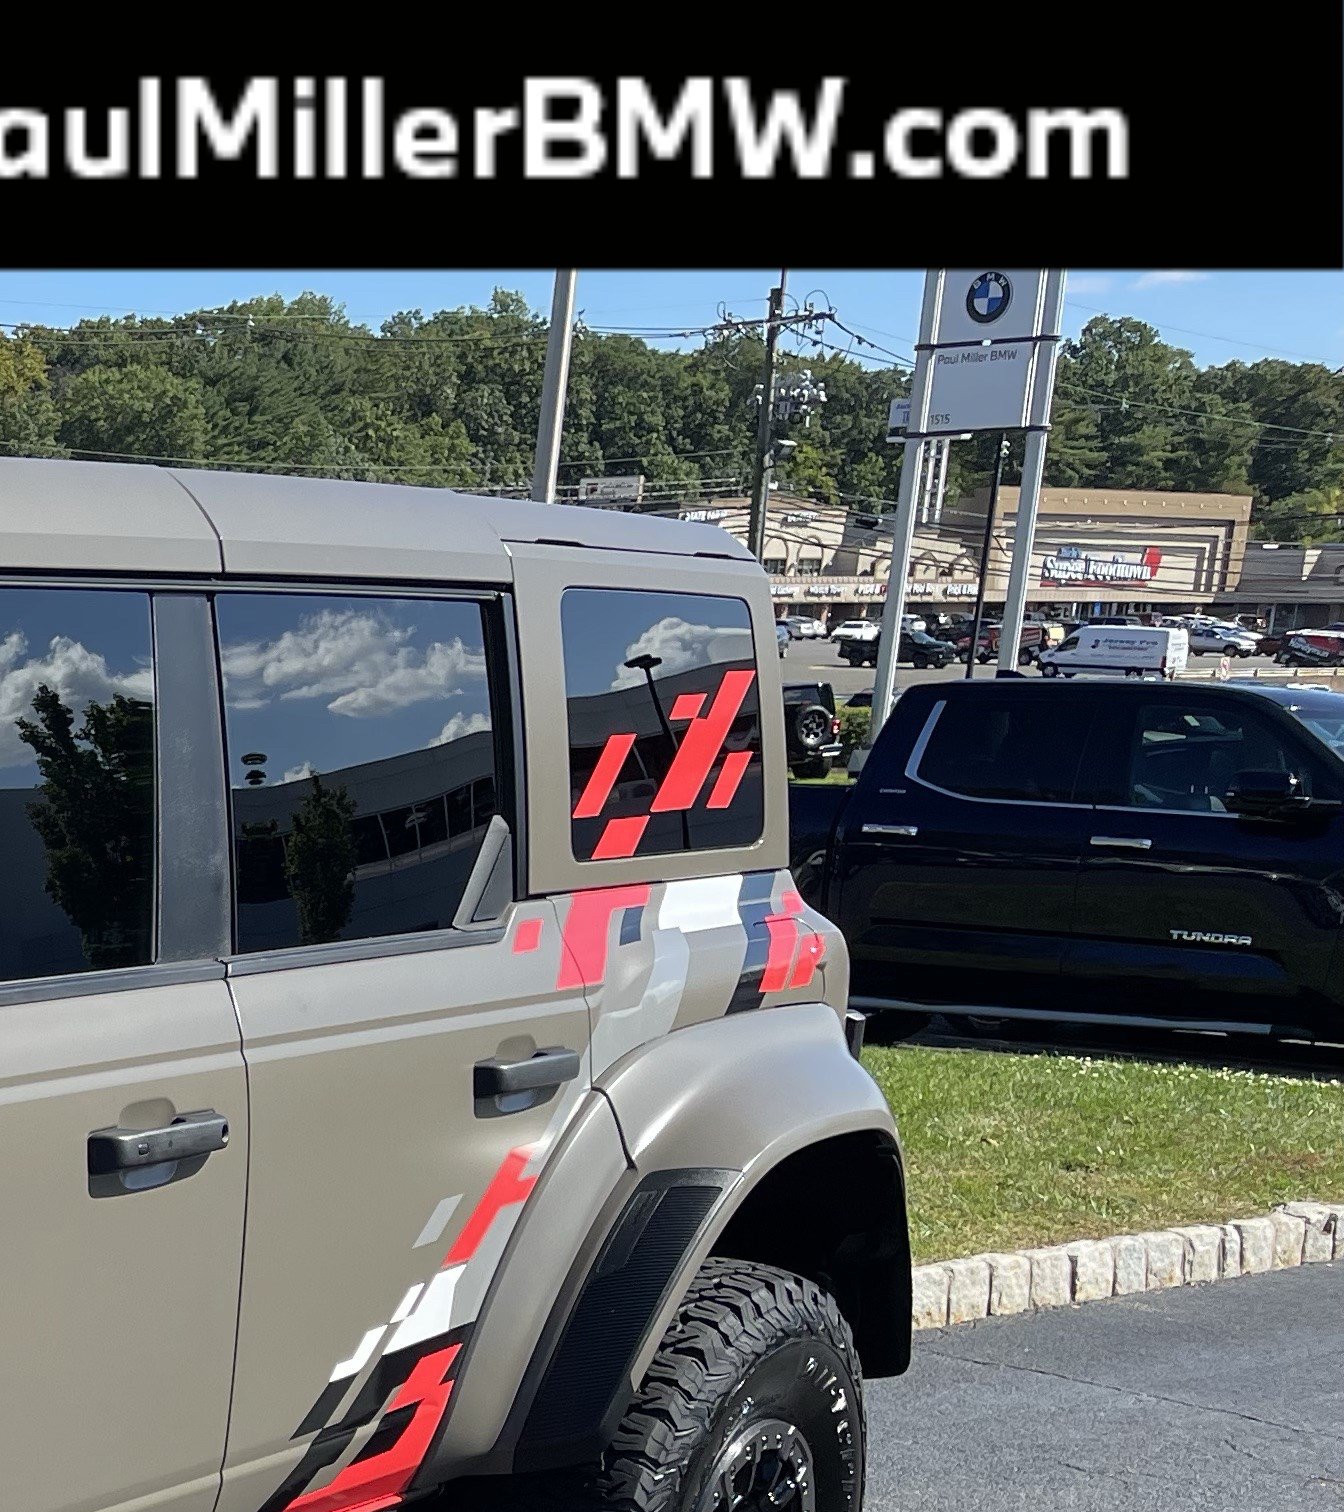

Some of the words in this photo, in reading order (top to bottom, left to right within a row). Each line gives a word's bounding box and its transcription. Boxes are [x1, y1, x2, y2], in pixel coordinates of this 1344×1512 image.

[972, 272, 1009, 290] BMW
[937, 353, 959, 365] Paul
[960, 351, 988, 364] Miller
[989, 349, 1018, 362] BMW
[929, 413, 951, 426] 1515
[1169, 929, 1253, 946] TUNDRA
